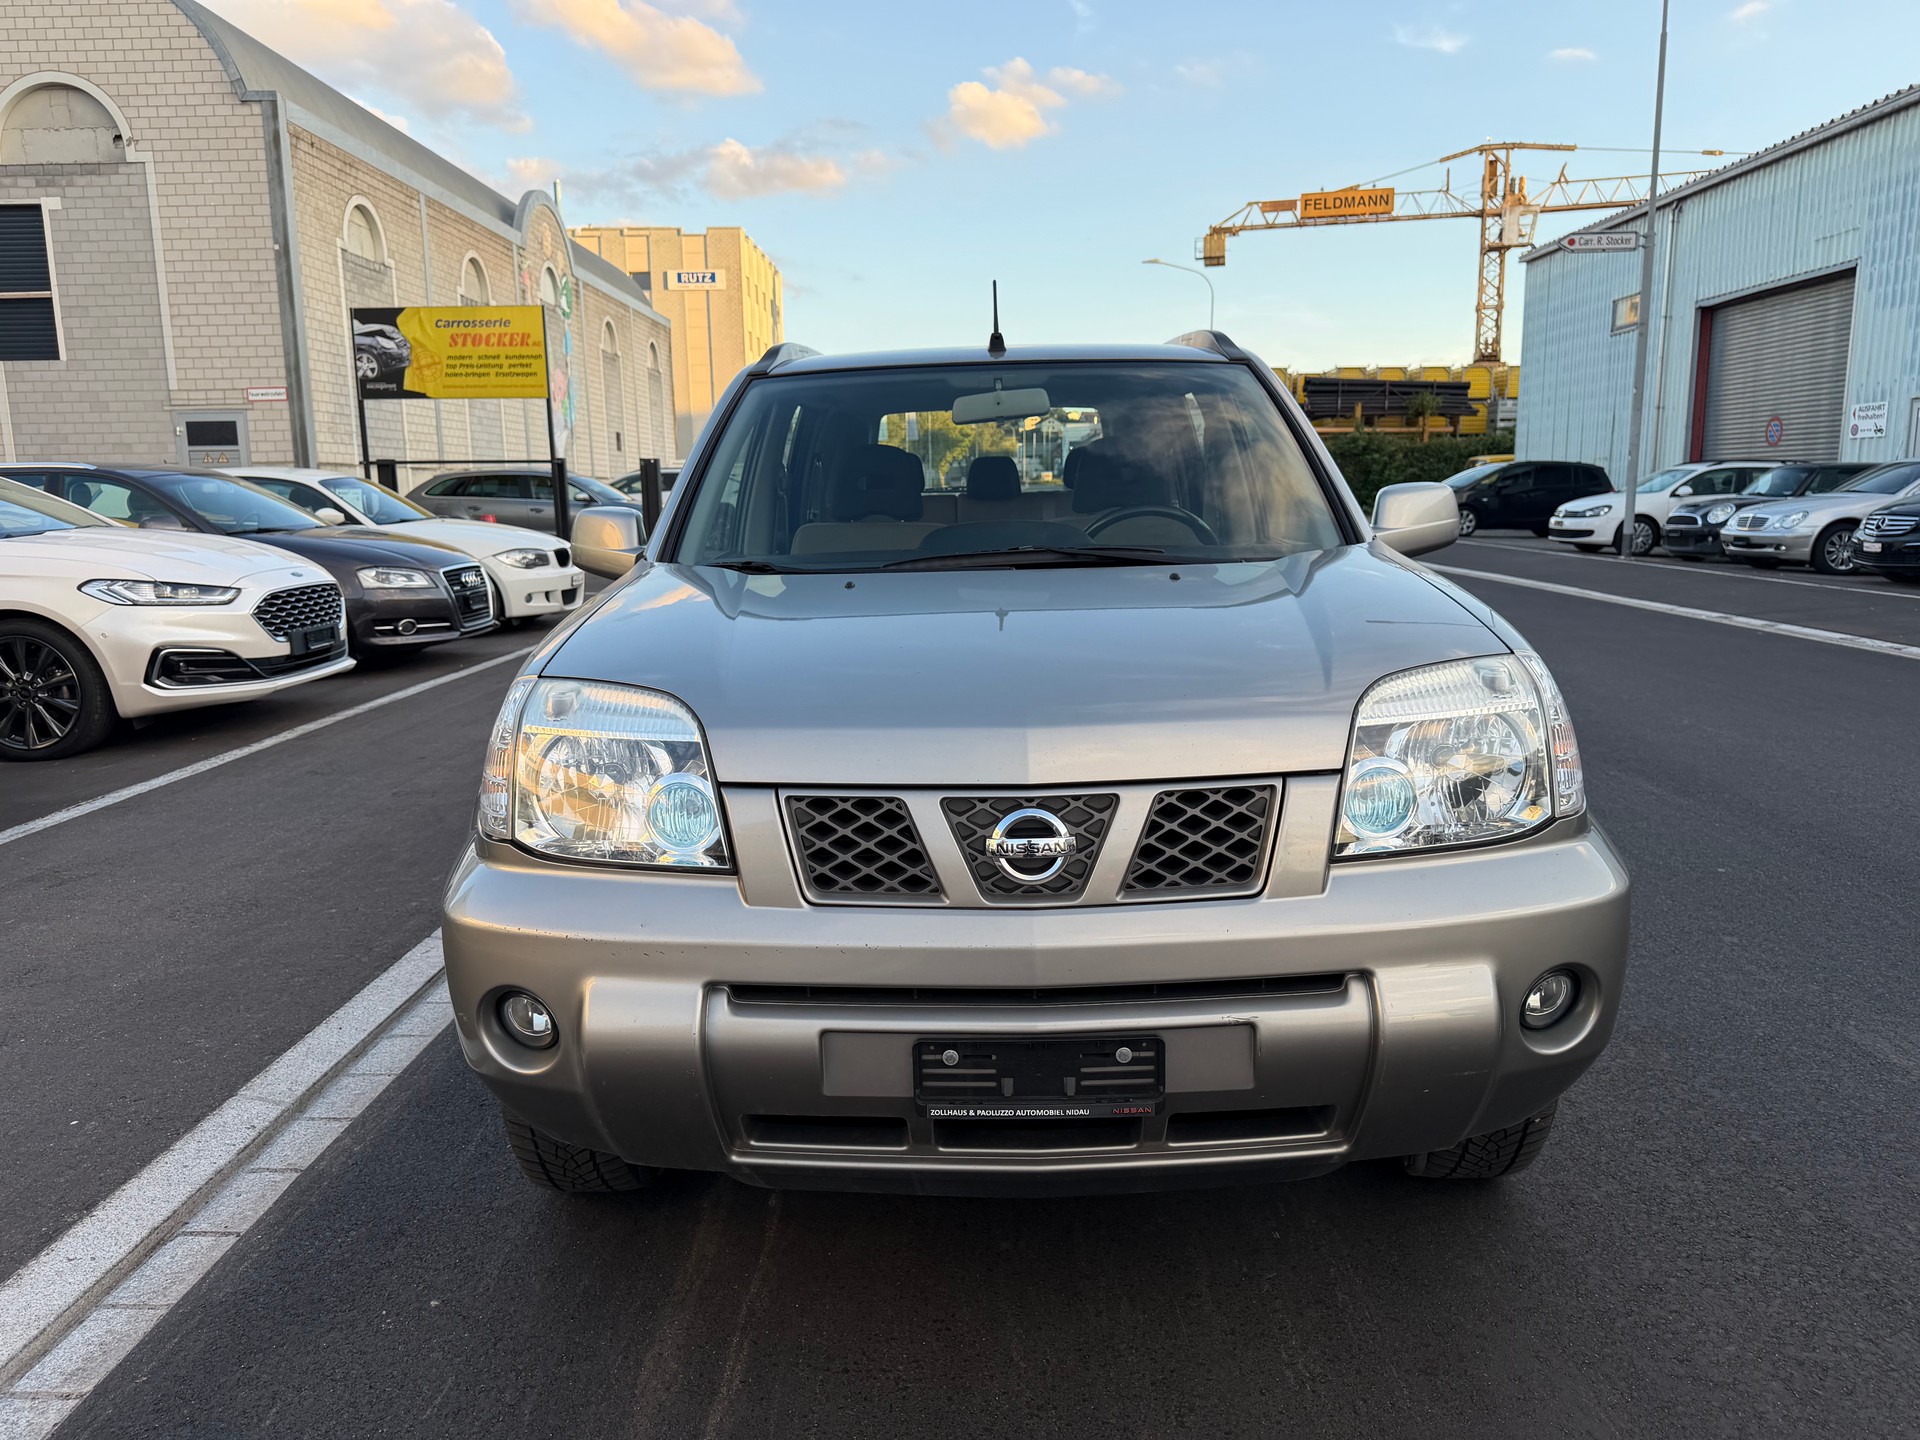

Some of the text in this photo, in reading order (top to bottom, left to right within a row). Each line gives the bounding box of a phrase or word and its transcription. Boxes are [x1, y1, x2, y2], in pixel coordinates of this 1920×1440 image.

[1304, 194, 1389, 211] FELDMANN
[1578, 236, 1632, 246] Carr. R. Stocker
[680, 273, 712, 283] RUTZ
[435, 318, 511, 328] Carrosserie
[449, 332, 531, 347] STOCKER
[1858, 404, 1885, 412] AUSFAHRT
[996, 842, 1067, 854] NISSAN
